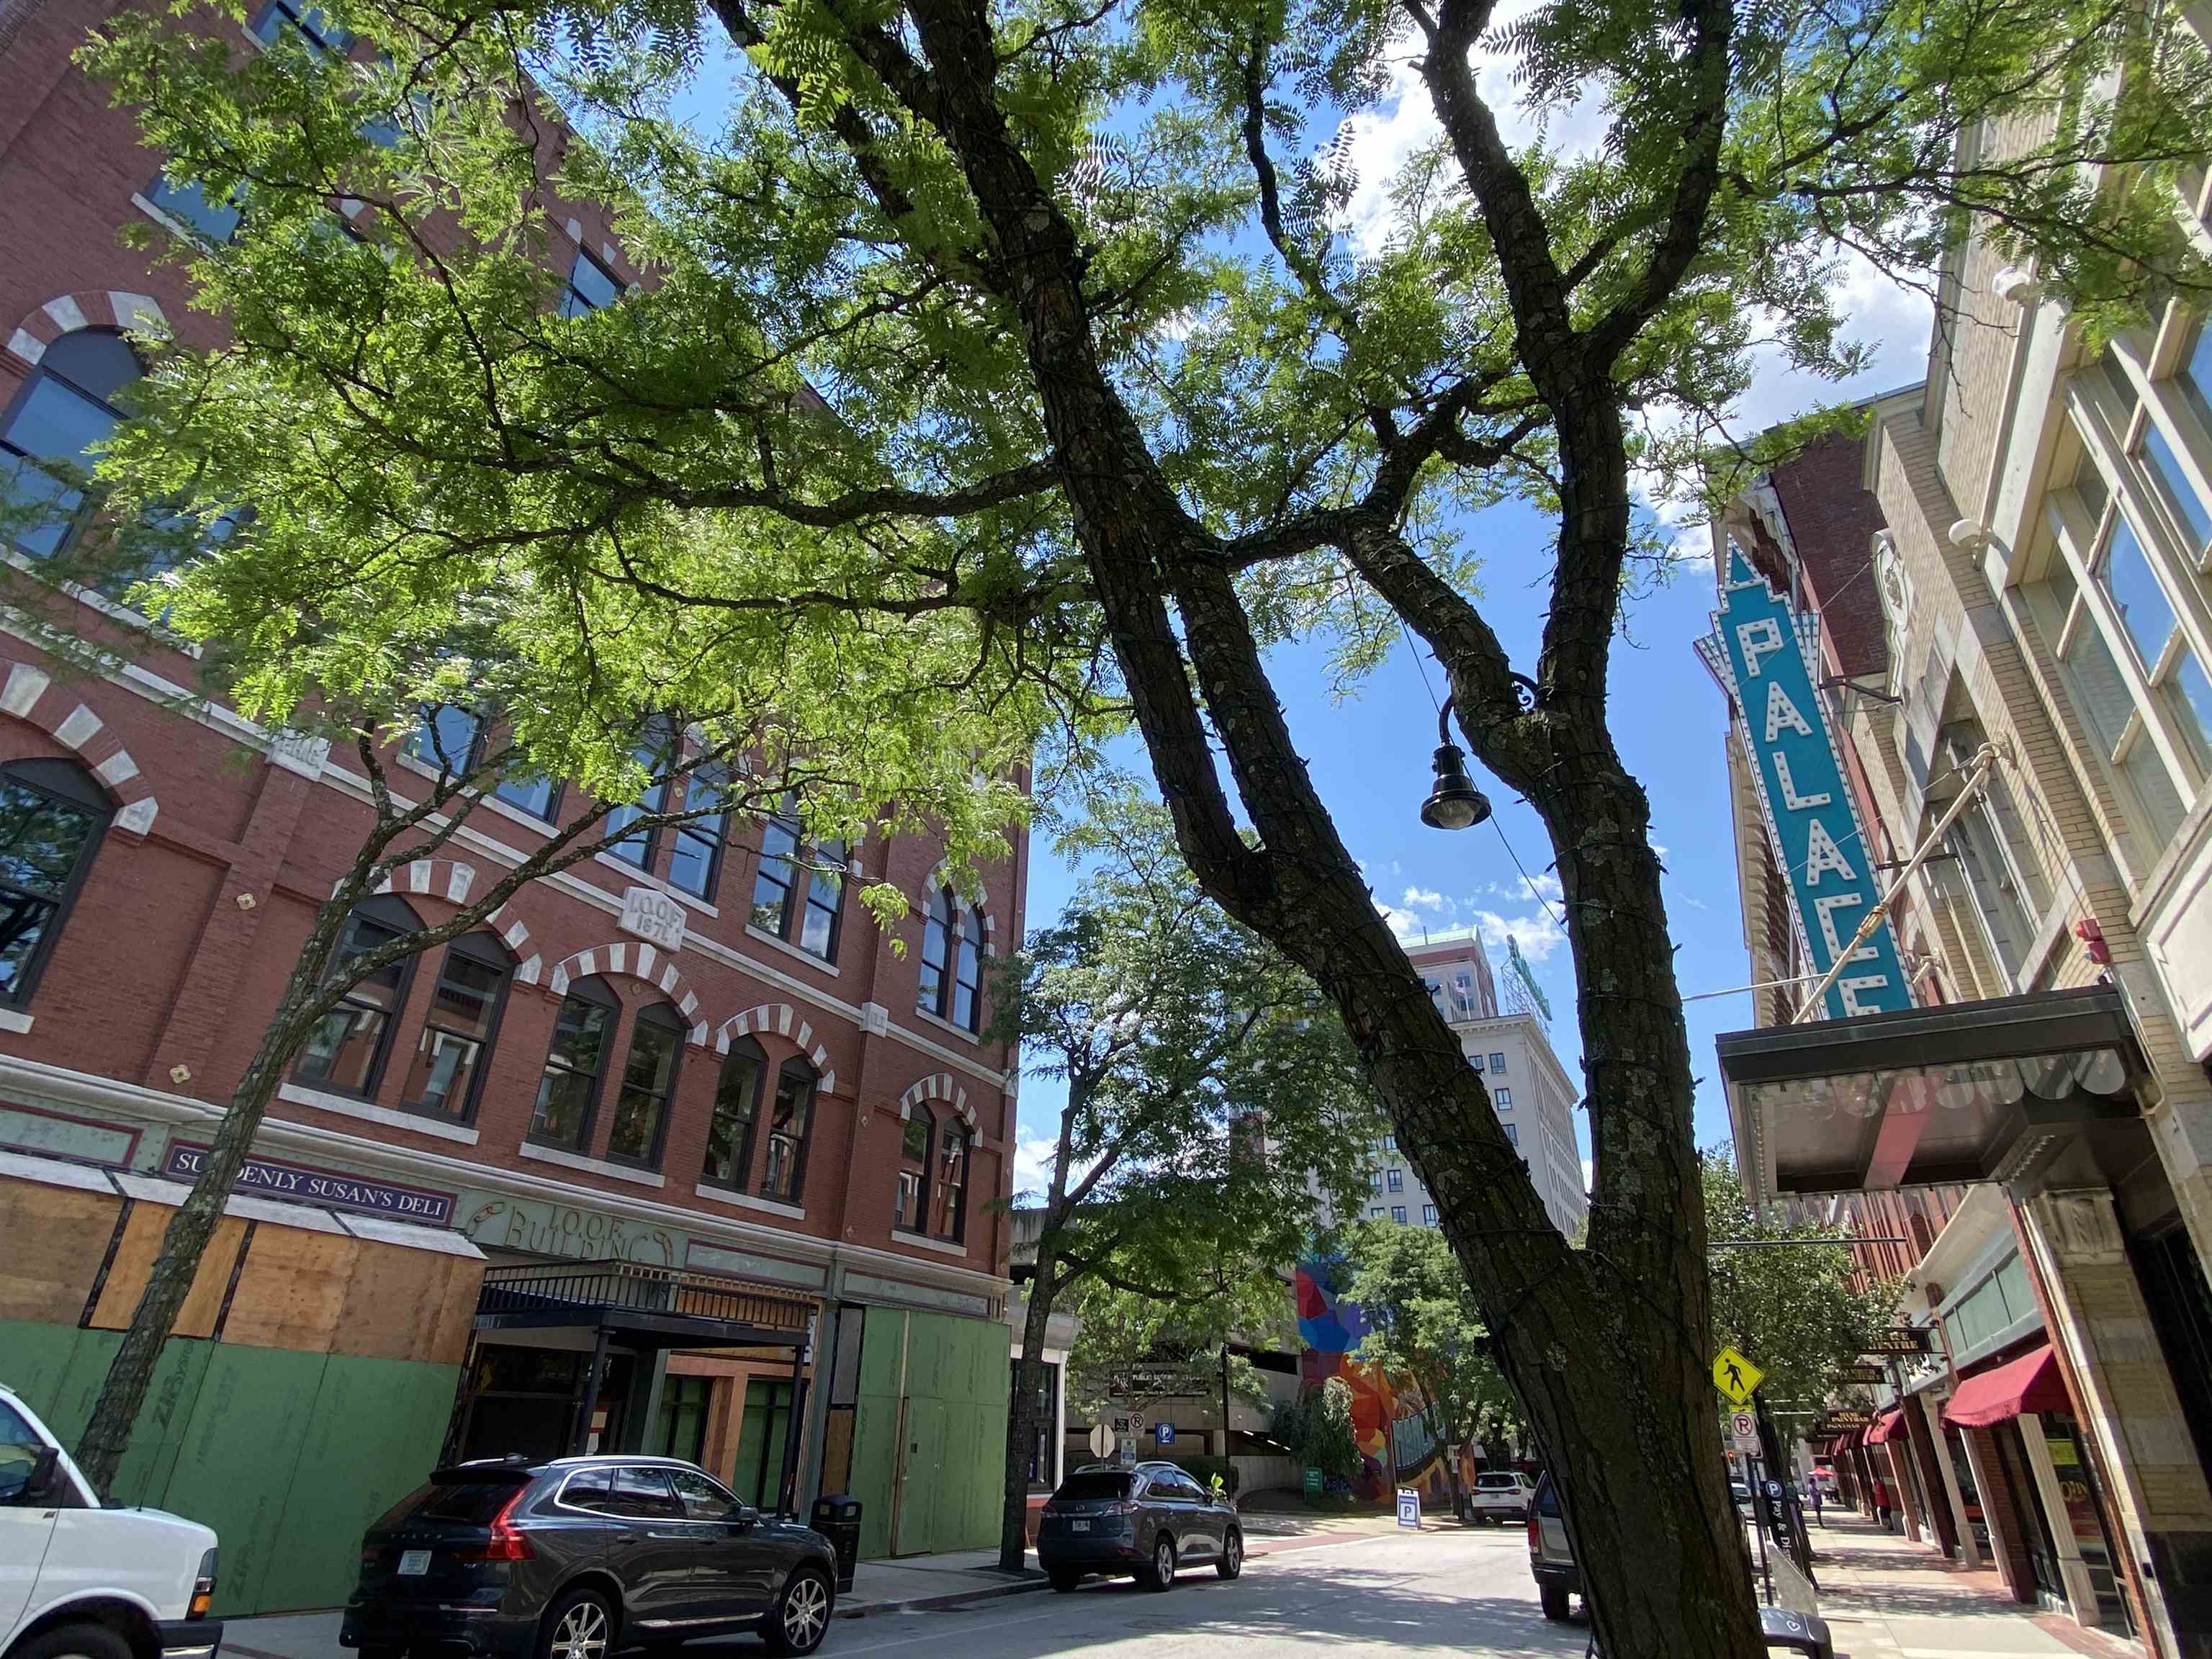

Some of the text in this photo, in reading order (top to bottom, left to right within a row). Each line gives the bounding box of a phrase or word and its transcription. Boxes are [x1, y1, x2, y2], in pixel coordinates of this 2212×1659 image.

[1735, 617, 1888, 1015] PALACE
[308, 1179, 394, 1208] SUSAN'S
[397, 1195, 444, 1217] DELI
[1404, 1506, 1412, 1517] P
[1772, 1501, 1783, 1519] Pay
